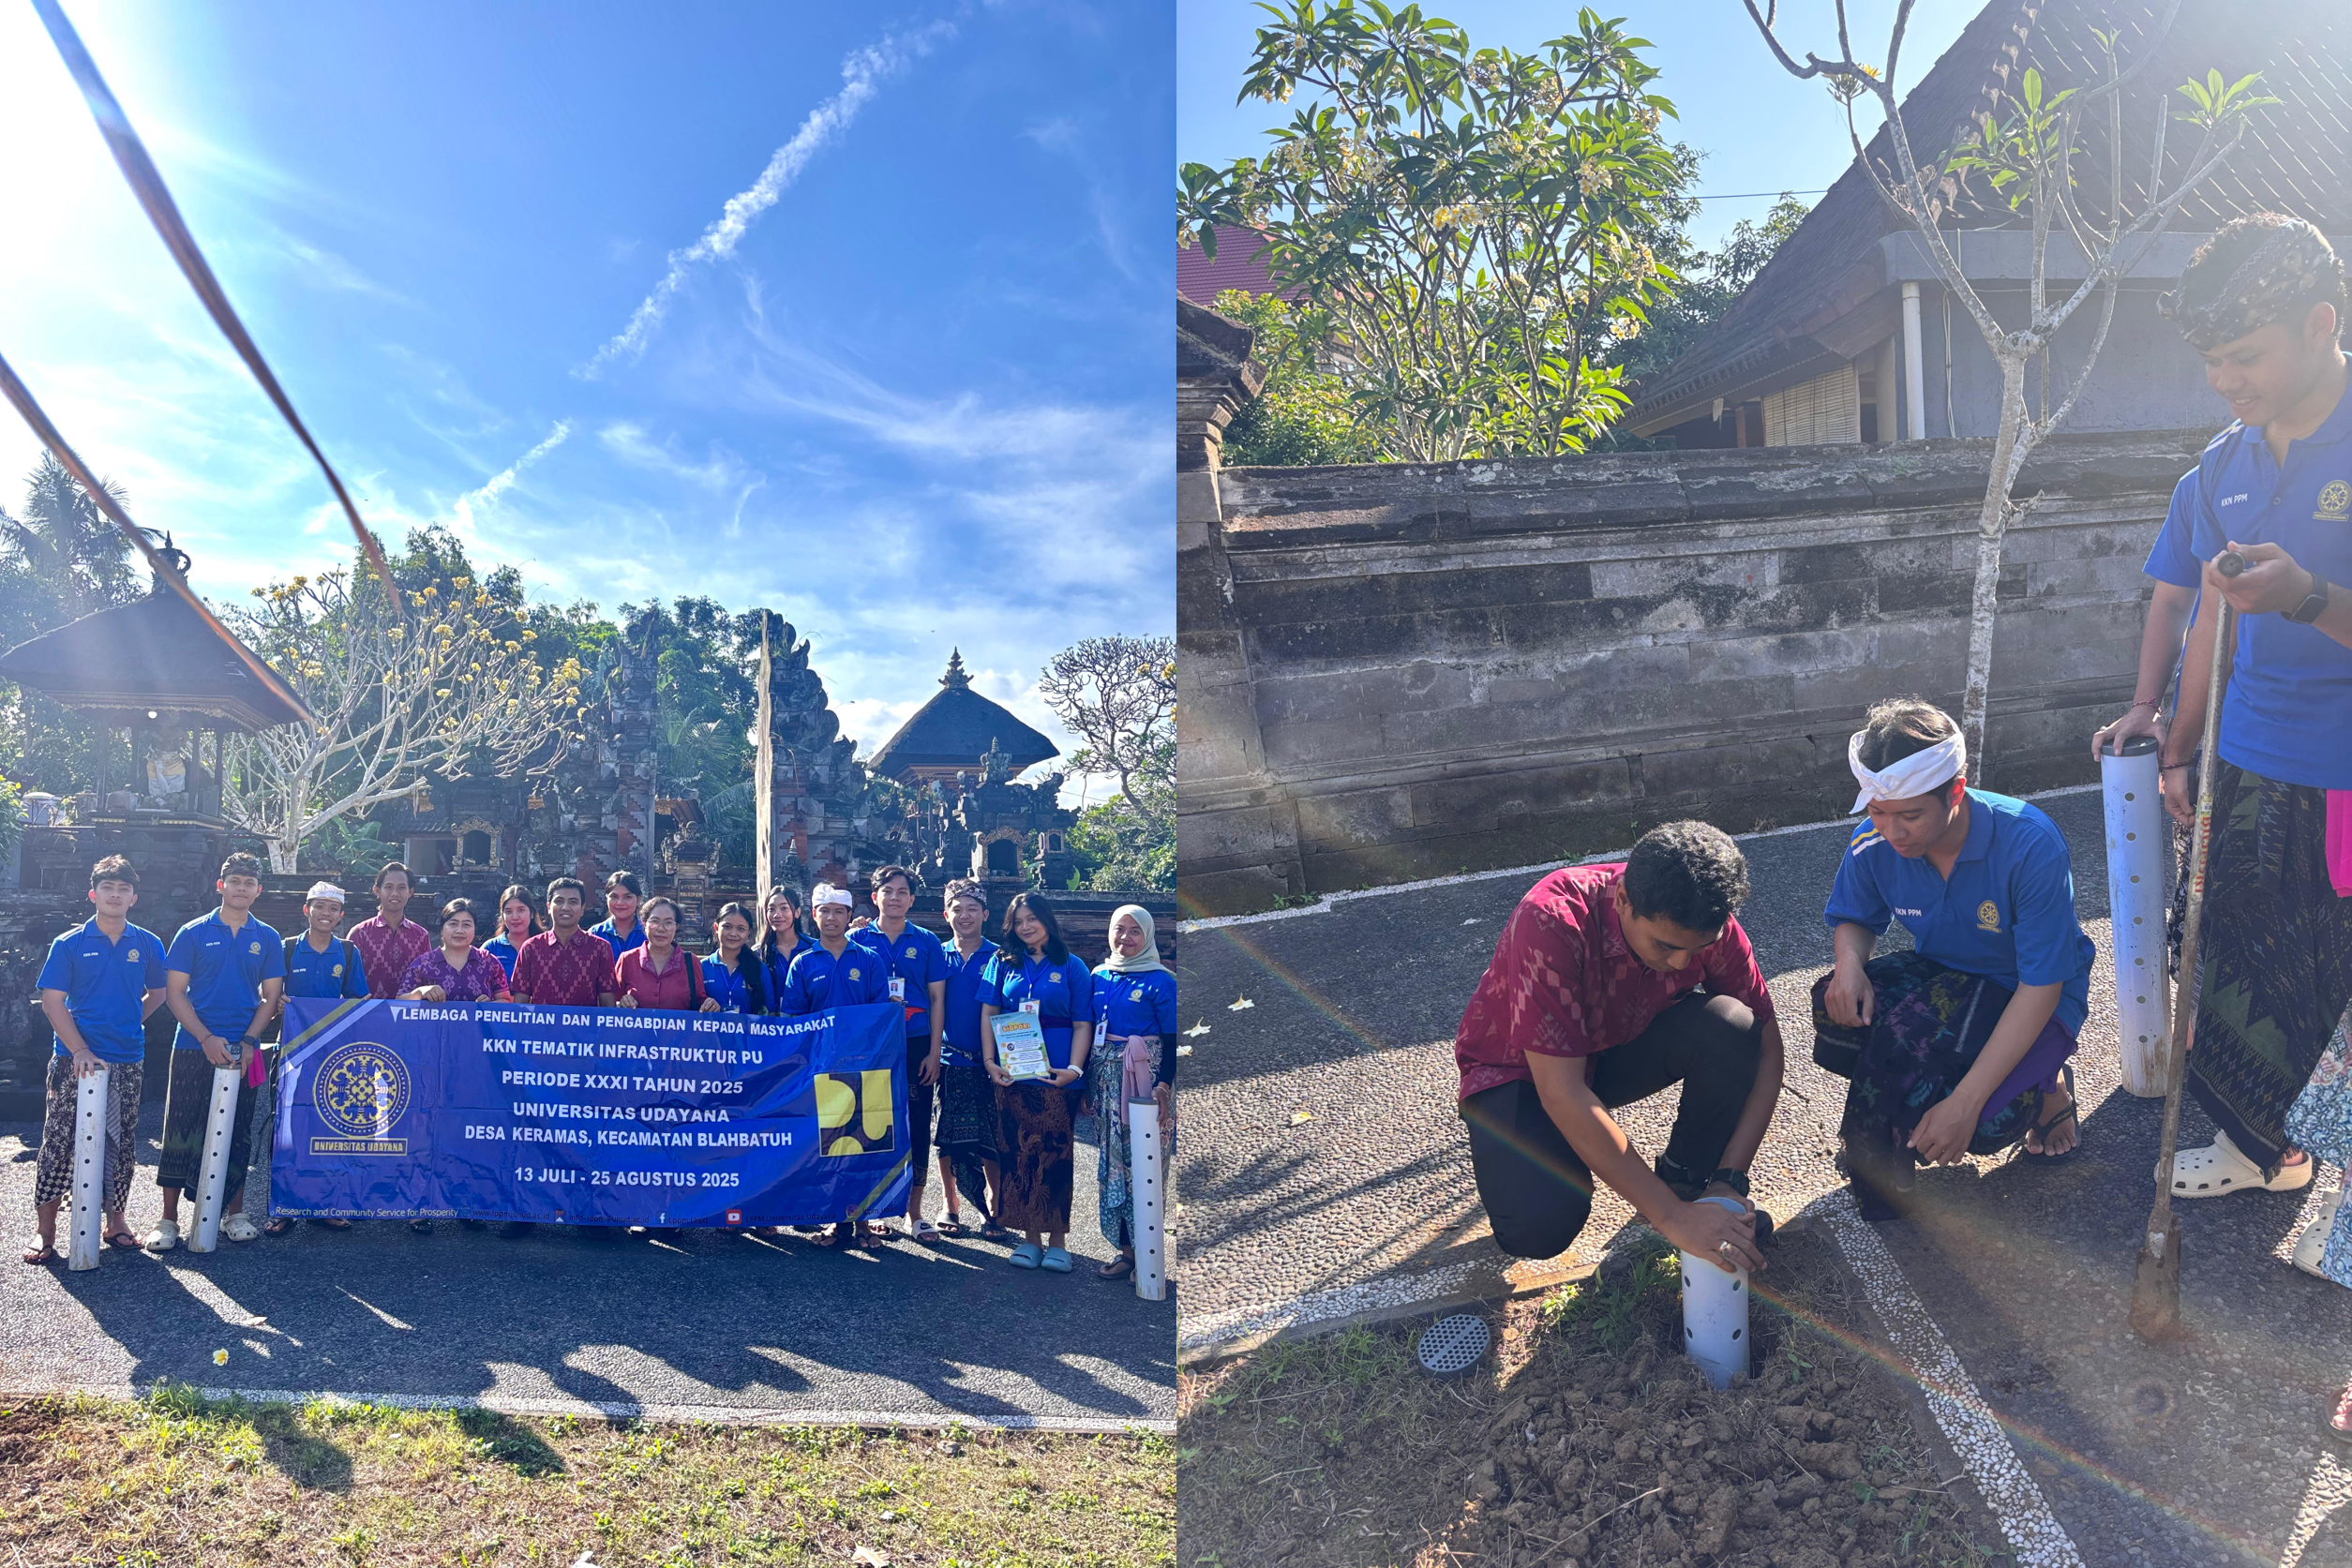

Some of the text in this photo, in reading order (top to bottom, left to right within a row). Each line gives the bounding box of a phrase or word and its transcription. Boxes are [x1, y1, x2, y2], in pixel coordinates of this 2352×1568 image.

[2221, 493, 2248, 507] KKN PPM
[1895, 906, 1922, 917] KKN PPM
[401, 1008, 836, 1036] LEMBAGA PENELITIAN DAN PENGABDIAN KEPADA MASYARAKAT
[482, 1038, 763, 1064] KKN TEMATIK INFRASTRUKTUR PU
[502, 1070, 743, 1094] PERIODE XXXI TAHUN 2025
[513, 1102, 729, 1123] UNIVERSITAS UDAYANA
[465, 1125, 792, 1147] DESA KERAMAS, KECAMATAN BLAHBATUH
[314, 1141, 403, 1152] UNIVERSITAS UDAYANA
[516, 1168, 534, 1182] 13
[538, 1168, 576, 1184] JULI
[591, 1171, 610, 1185] 25
[615, 1172, 697, 1187] AGUSTUS
[701, 1172, 740, 1187] 2025
[276, 1206, 459, 1218] Research and Community Service for Prosperity
[472, 1208, 550, 1220] www.lppm.unud.ac.id
[745, 1213, 836, 1223] LPPM Universitas Udayana
